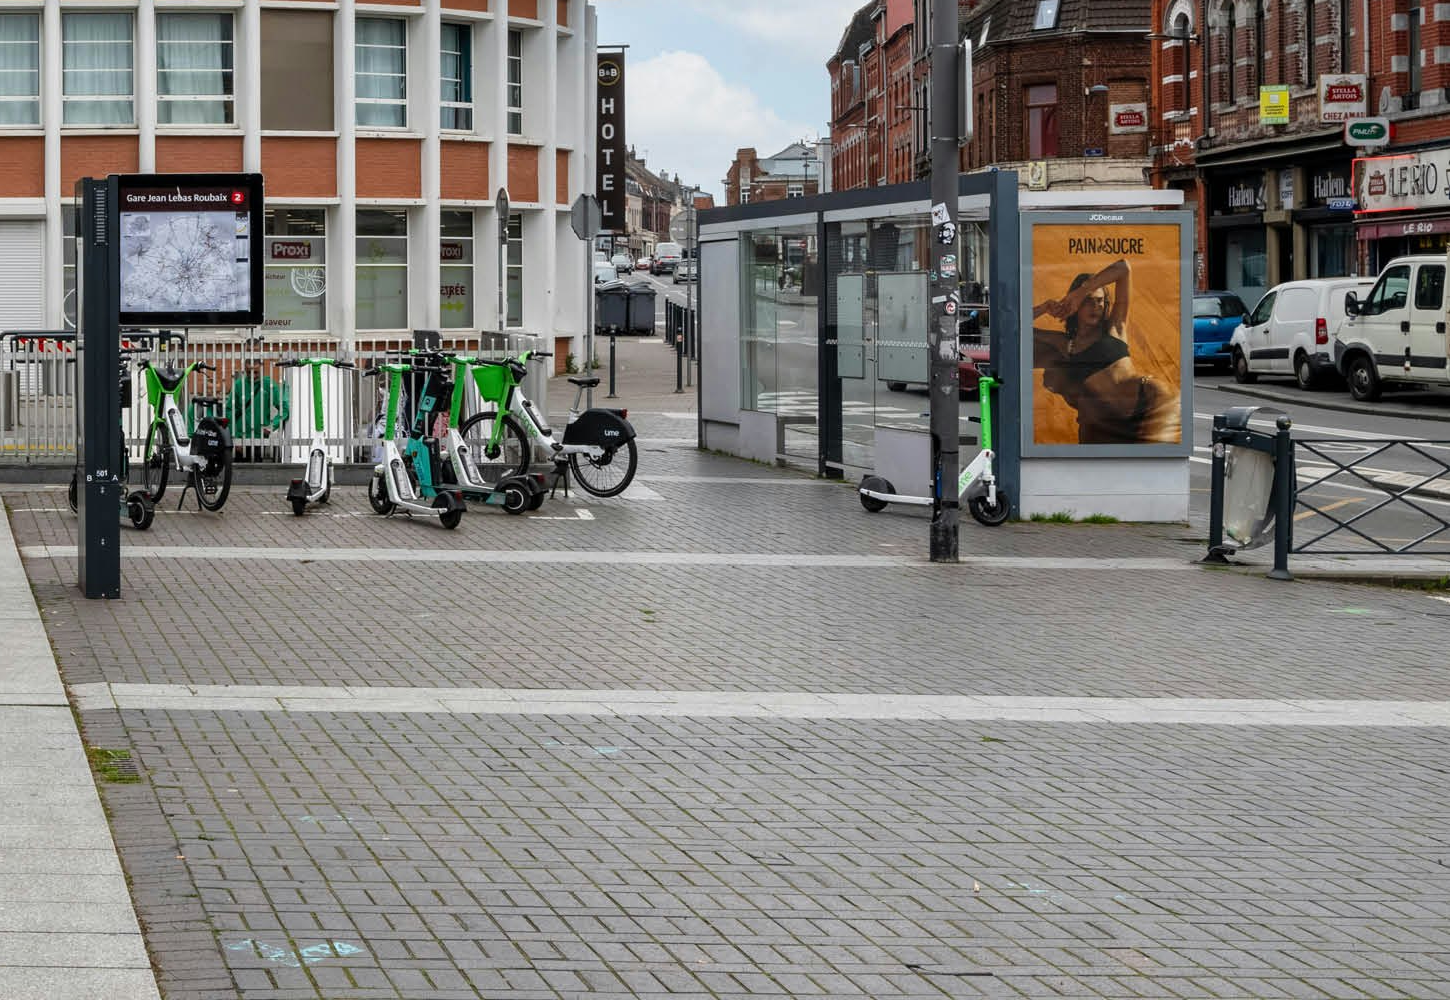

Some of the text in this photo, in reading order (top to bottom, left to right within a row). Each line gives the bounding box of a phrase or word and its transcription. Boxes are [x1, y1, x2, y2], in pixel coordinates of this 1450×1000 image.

[599, 68, 617, 77] B&B
[1323, 112, 1342, 120] CHEZ
[601, 98, 614, 216] HOTEL
[1314, 172, 1344, 198] Harlem
[1389, 163, 1437, 197] LE RIO
[126, 194, 227, 202] Gare Jean Lebas Roubaix
[234, 193, 242, 202] 2
[1229, 184, 1255, 207] Harlem
[1403, 222, 1433, 234] LE RIO
[273, 243, 309, 256] Proxi
[1069, 237, 1096, 254] PAIN
[1105, 238, 1145, 254] SUCRE
[441, 247, 461, 257] roxi
[87, 474, 93, 482] B
